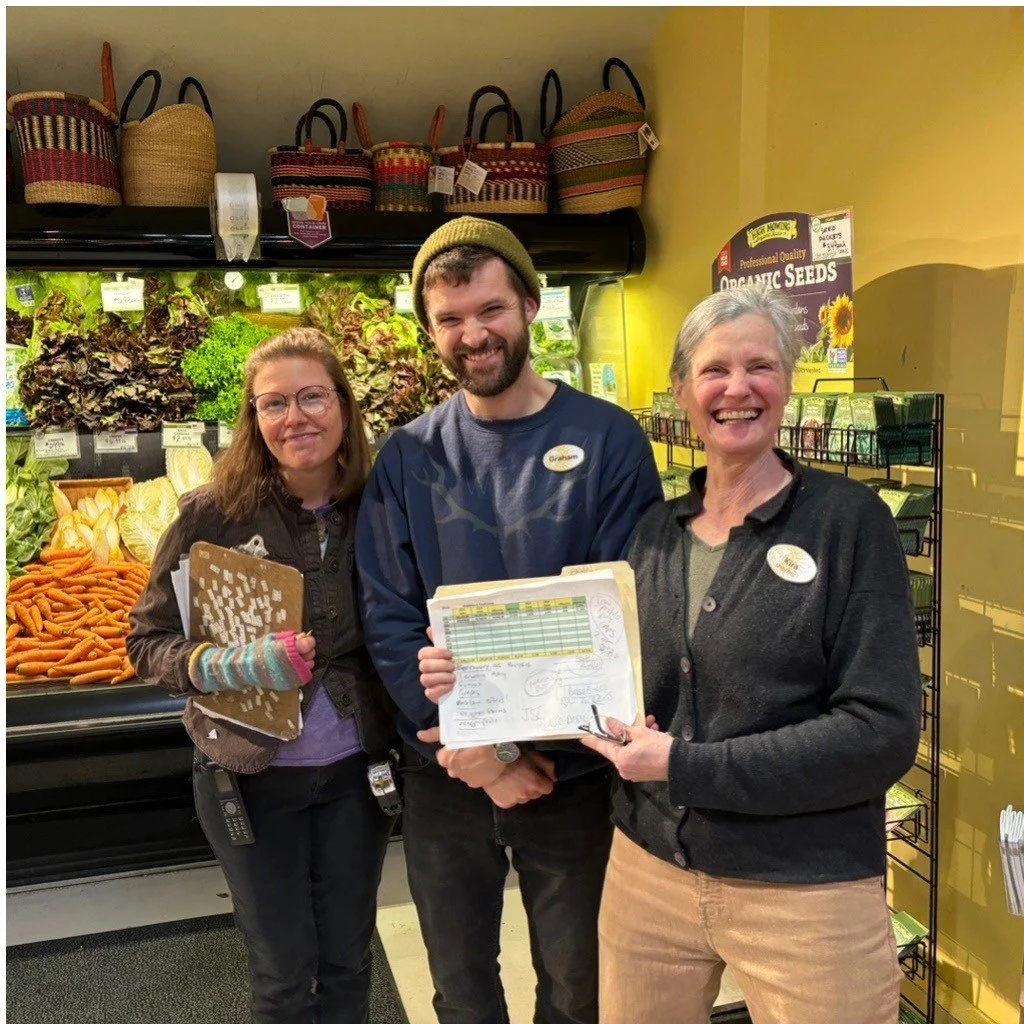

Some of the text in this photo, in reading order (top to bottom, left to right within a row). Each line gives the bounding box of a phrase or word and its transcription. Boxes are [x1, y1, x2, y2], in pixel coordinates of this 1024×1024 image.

[739, 251, 779, 269] Professional
[780, 249, 807, 262] Quality
[784, 261, 838, 288] SEEDS
[548, 451, 578, 464] Graham
[784, 557, 799, 570] Kira
